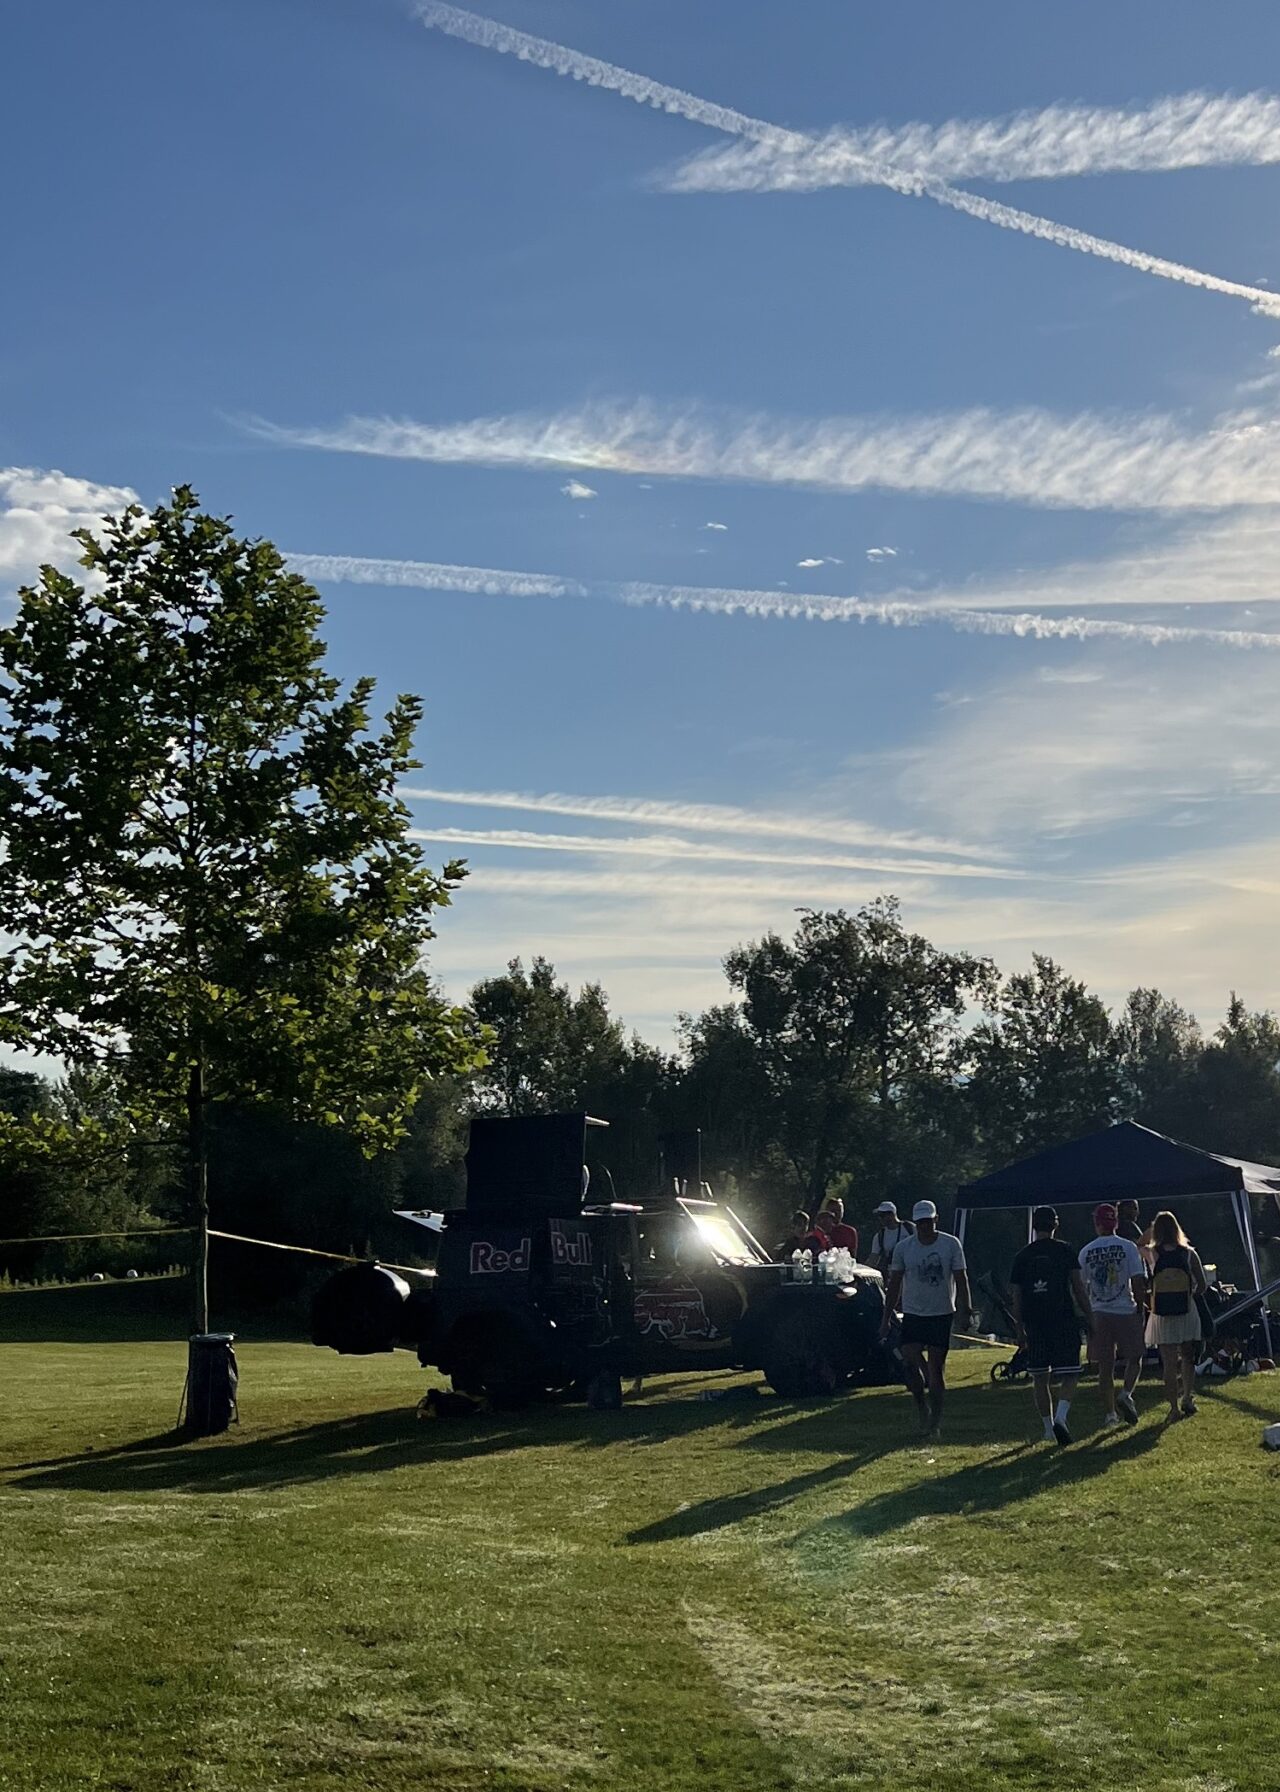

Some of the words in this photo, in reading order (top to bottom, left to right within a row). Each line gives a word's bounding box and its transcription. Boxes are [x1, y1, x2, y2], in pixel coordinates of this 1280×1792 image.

[470, 1237, 531, 1275] Red
[551, 1231, 593, 1266] Bull
[1087, 1245, 1124, 1256] NEVER
[1085, 1251, 1127, 1264] ENDING
